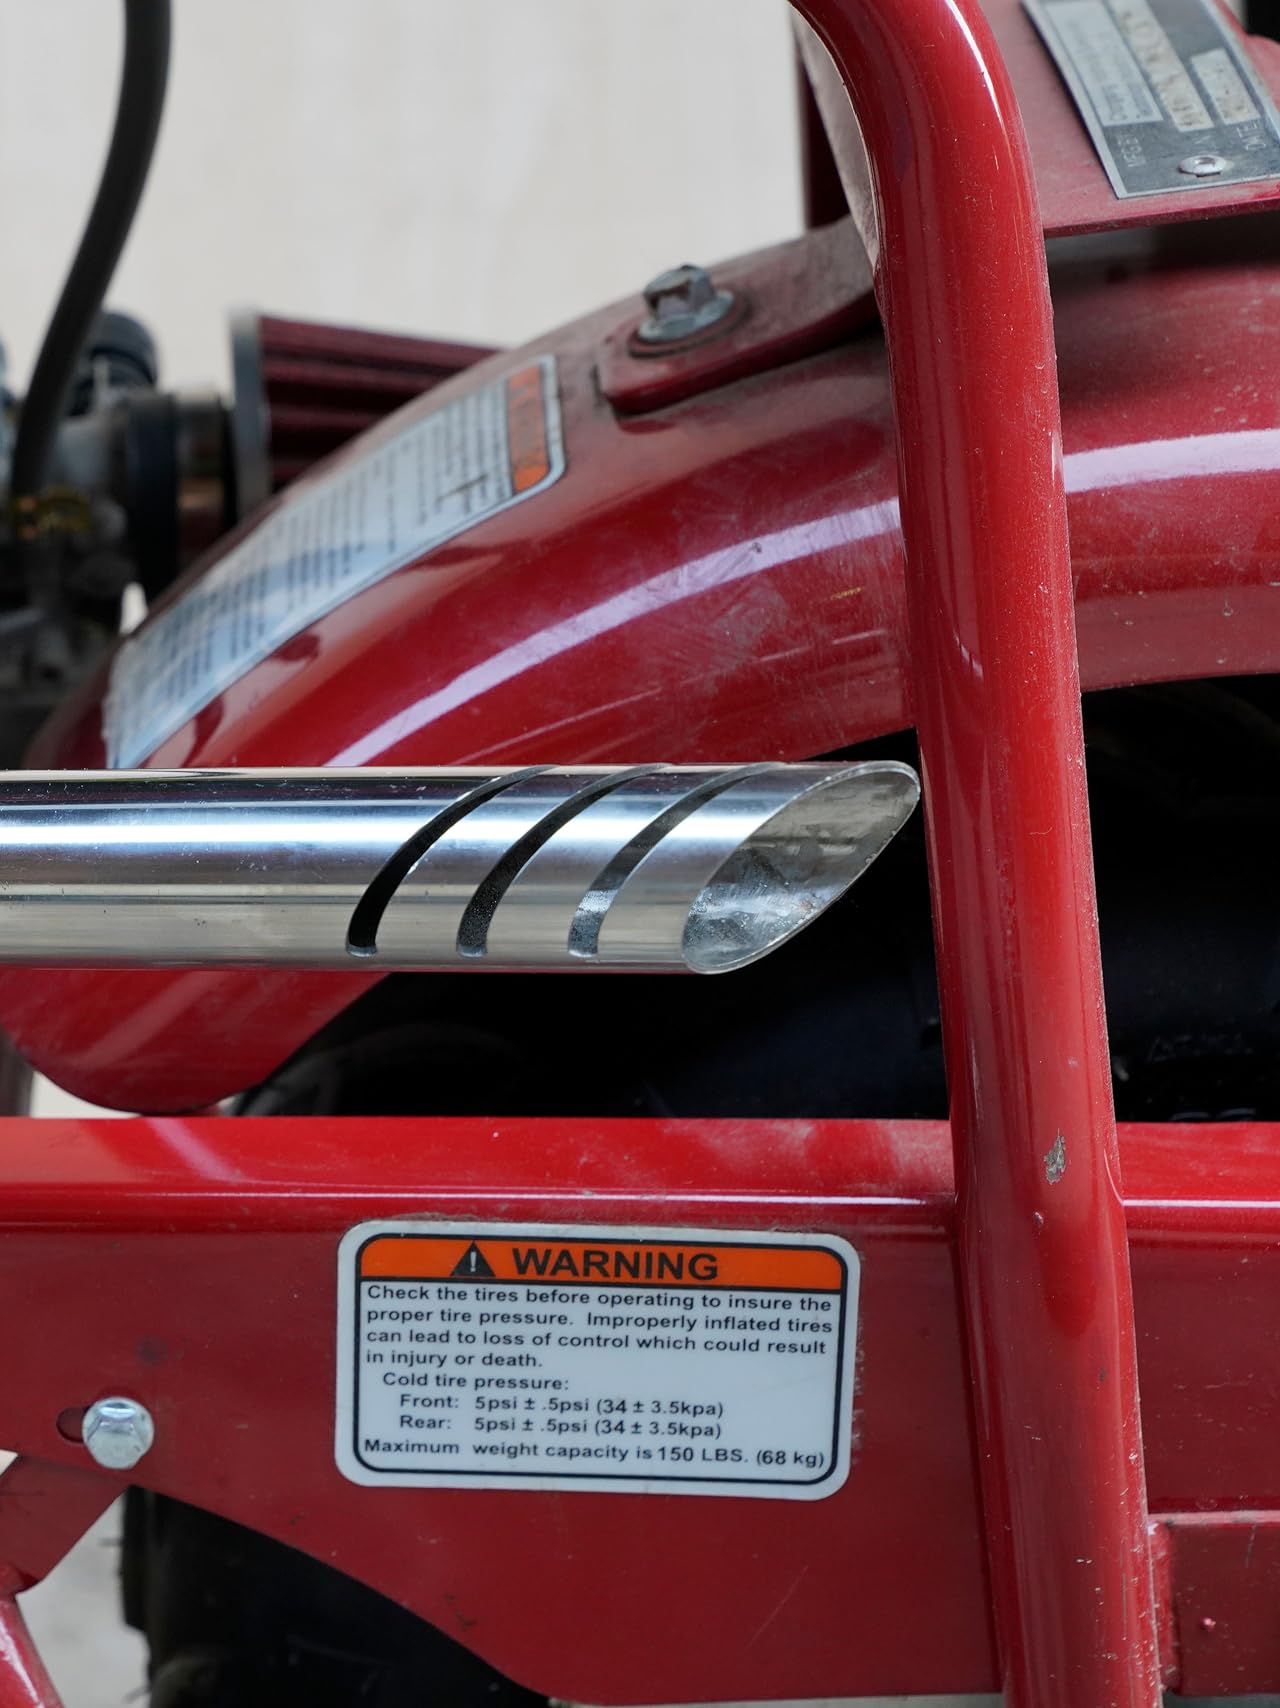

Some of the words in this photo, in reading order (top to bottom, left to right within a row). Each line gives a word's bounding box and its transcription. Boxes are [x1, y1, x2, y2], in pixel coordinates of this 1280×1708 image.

[512, 1247, 718, 1280] WARNING
[367, 1285, 430, 1300] Check
[437, 1286, 468, 1301] the
[474, 1287, 519, 1303] tires
[526, 1288, 590, 1304] before
[597, 1292, 694, 1311] operating
[701, 1295, 721, 1308] to
[728, 1294, 793, 1310] insure
[799, 1297, 832, 1312] the
[367, 1310, 434, 1325] proper
[440, 1308, 472, 1323] tire
[479, 1312, 573, 1326] pressure.
[587, 1312, 698, 1333] Improperly
[705, 1315, 781, 1331] inflated
[787, 1318, 833, 1333] tires
[366, 1331, 402, 1343] can
[409, 1329, 450, 1344] lead
[457, 1331, 476, 1344] to
[483, 1330, 525, 1346] loss
[531, 1332, 552, 1346] of
[557, 1334, 629, 1348] control
[636, 1335, 696, 1350] which
[703, 1338, 760, 1352] could
[767, 1340, 826, 1355] result
[366, 1349, 384, 1364] in
[391, 1350, 448, 1368] injury
[454, 1354, 475, 1366] or
[481, 1352, 542, 1367] death.
[382, 1372, 428, 1387] Cold
[435, 1373, 467, 1388] tire
[474, 1377, 568, 1392] pressure:
[400, 1393, 459, 1408] Front:
[475, 1396, 517, 1413] 5psi
[542, 1397, 589, 1414] .5psi
[596, 1398, 628, 1416] (34
[651, 1400, 723, 1419] 3.5kpa)
[400, 1414, 451, 1429] Rear:
[474, 1417, 516, 1433] 5psi
[541, 1418, 587, 1436] .5psi
[594, 1419, 626, 1436] (34
[649, 1421, 722, 1440] 3.5kpa)
[364, 1438, 460, 1454] Maximum
[472, 1442, 539, 1459] weight
[545, 1445, 629, 1462] capacity
[636, 1446, 653, 1460] is
[658, 1446, 694, 1462] 150
[701, 1448, 748, 1463] LBS.
[756, 1450, 787, 1466] (68
[793, 1451, 825, 1469] kg)
